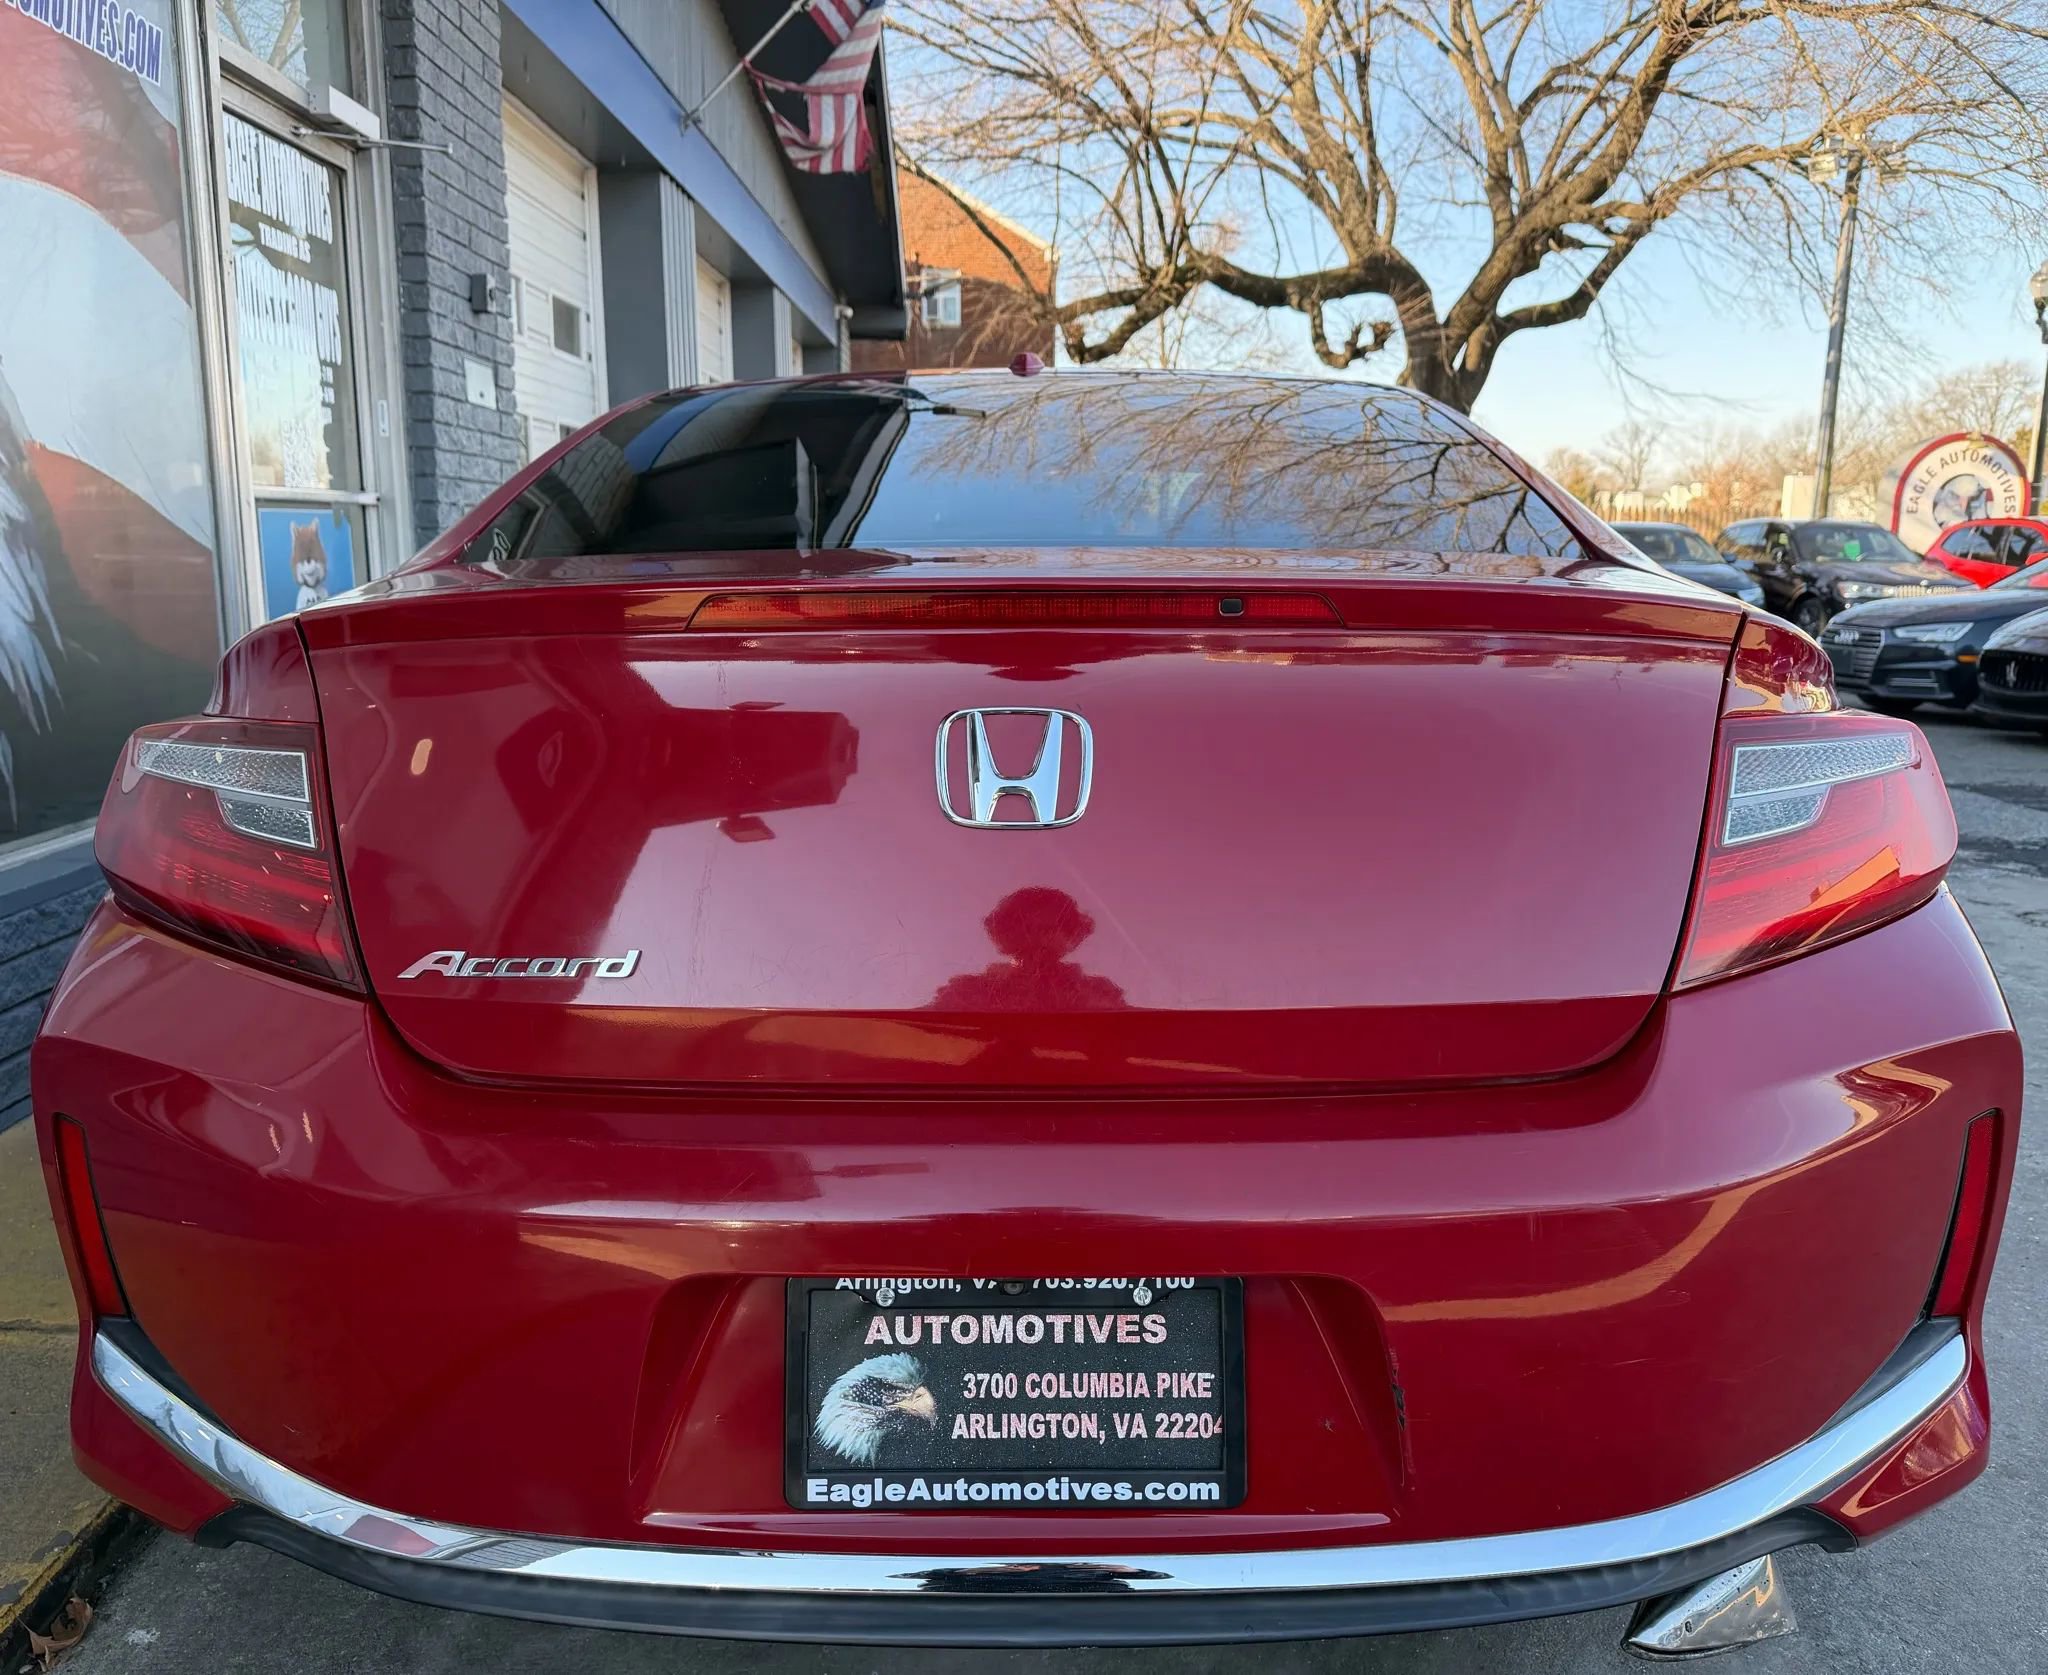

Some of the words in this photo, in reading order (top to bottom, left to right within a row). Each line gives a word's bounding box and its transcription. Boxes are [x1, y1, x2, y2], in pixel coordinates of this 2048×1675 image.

[1906, 466, 1938, 514] EAGLE
[1939, 448, 2017, 514] AUTOMOTIVES
[397, 949, 642, 979] Accord
[864, 1314, 1168, 1345] AUTOMOTIVES
[963, 1372, 1018, 1399] 3700
[1025, 1372, 1150, 1399] COLUMBIA
[1157, 1372, 1213, 1398] PIKE
[951, 1412, 1106, 1445] ARLINGTON,
[1113, 1412, 1148, 1439] VA
[807, 1476, 1220, 1508] EagleAutomotives.com
